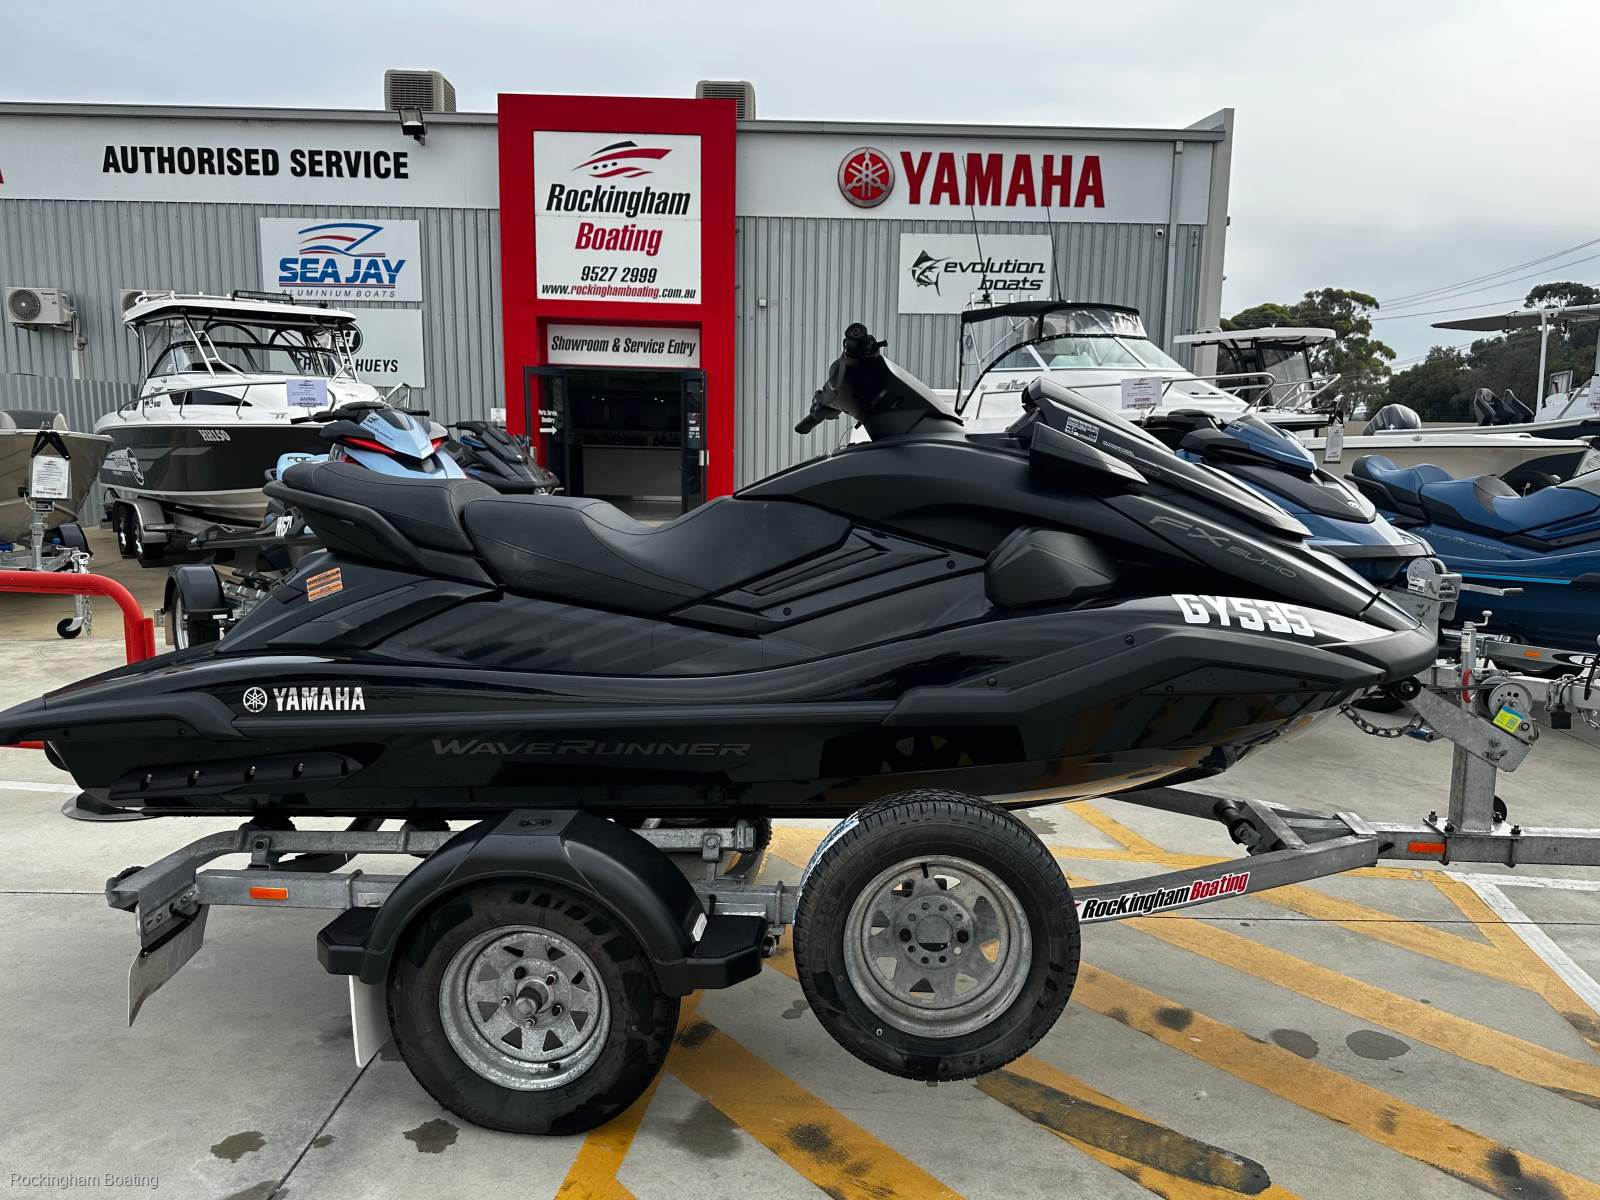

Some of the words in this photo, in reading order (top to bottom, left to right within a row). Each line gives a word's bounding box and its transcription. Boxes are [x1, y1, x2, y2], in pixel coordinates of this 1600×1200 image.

[103, 145, 280, 177] AUTHORISED
[290, 149, 409, 179] SERVICE
[899, 151, 1105, 208] YAMAHA
[546, 183, 691, 218] Rockingham
[574, 222, 663, 256] Boating
[279, 257, 341, 284] SEA
[344, 258, 406, 284] JAY
[580, 265, 618, 282] 9527
[620, 267, 657, 283] 2999
[944, 257, 1046, 274] evolution
[356, 290, 396, 298] BOATS
[541, 284, 696, 299] www.rockinghamboating.com.au
[977, 275, 1044, 291] boats
[551, 335, 609, 353] Showroom
[611, 338, 620, 352] &
[623, 337, 664, 354] Service
[666, 338, 696, 357] Entry
[355, 358, 399, 373] HUEYS
[1150, 515, 1230, 548] FX
[1225, 546, 1297, 578] SVHO
[1171, 593, 1315, 637] GY535
[272, 687, 365, 711] YAMAHA
[432, 739, 751, 757] WAVERUNNER
[1081, 886, 1190, 918] Rockingham
[1190, 873, 1249, 901] Boating
